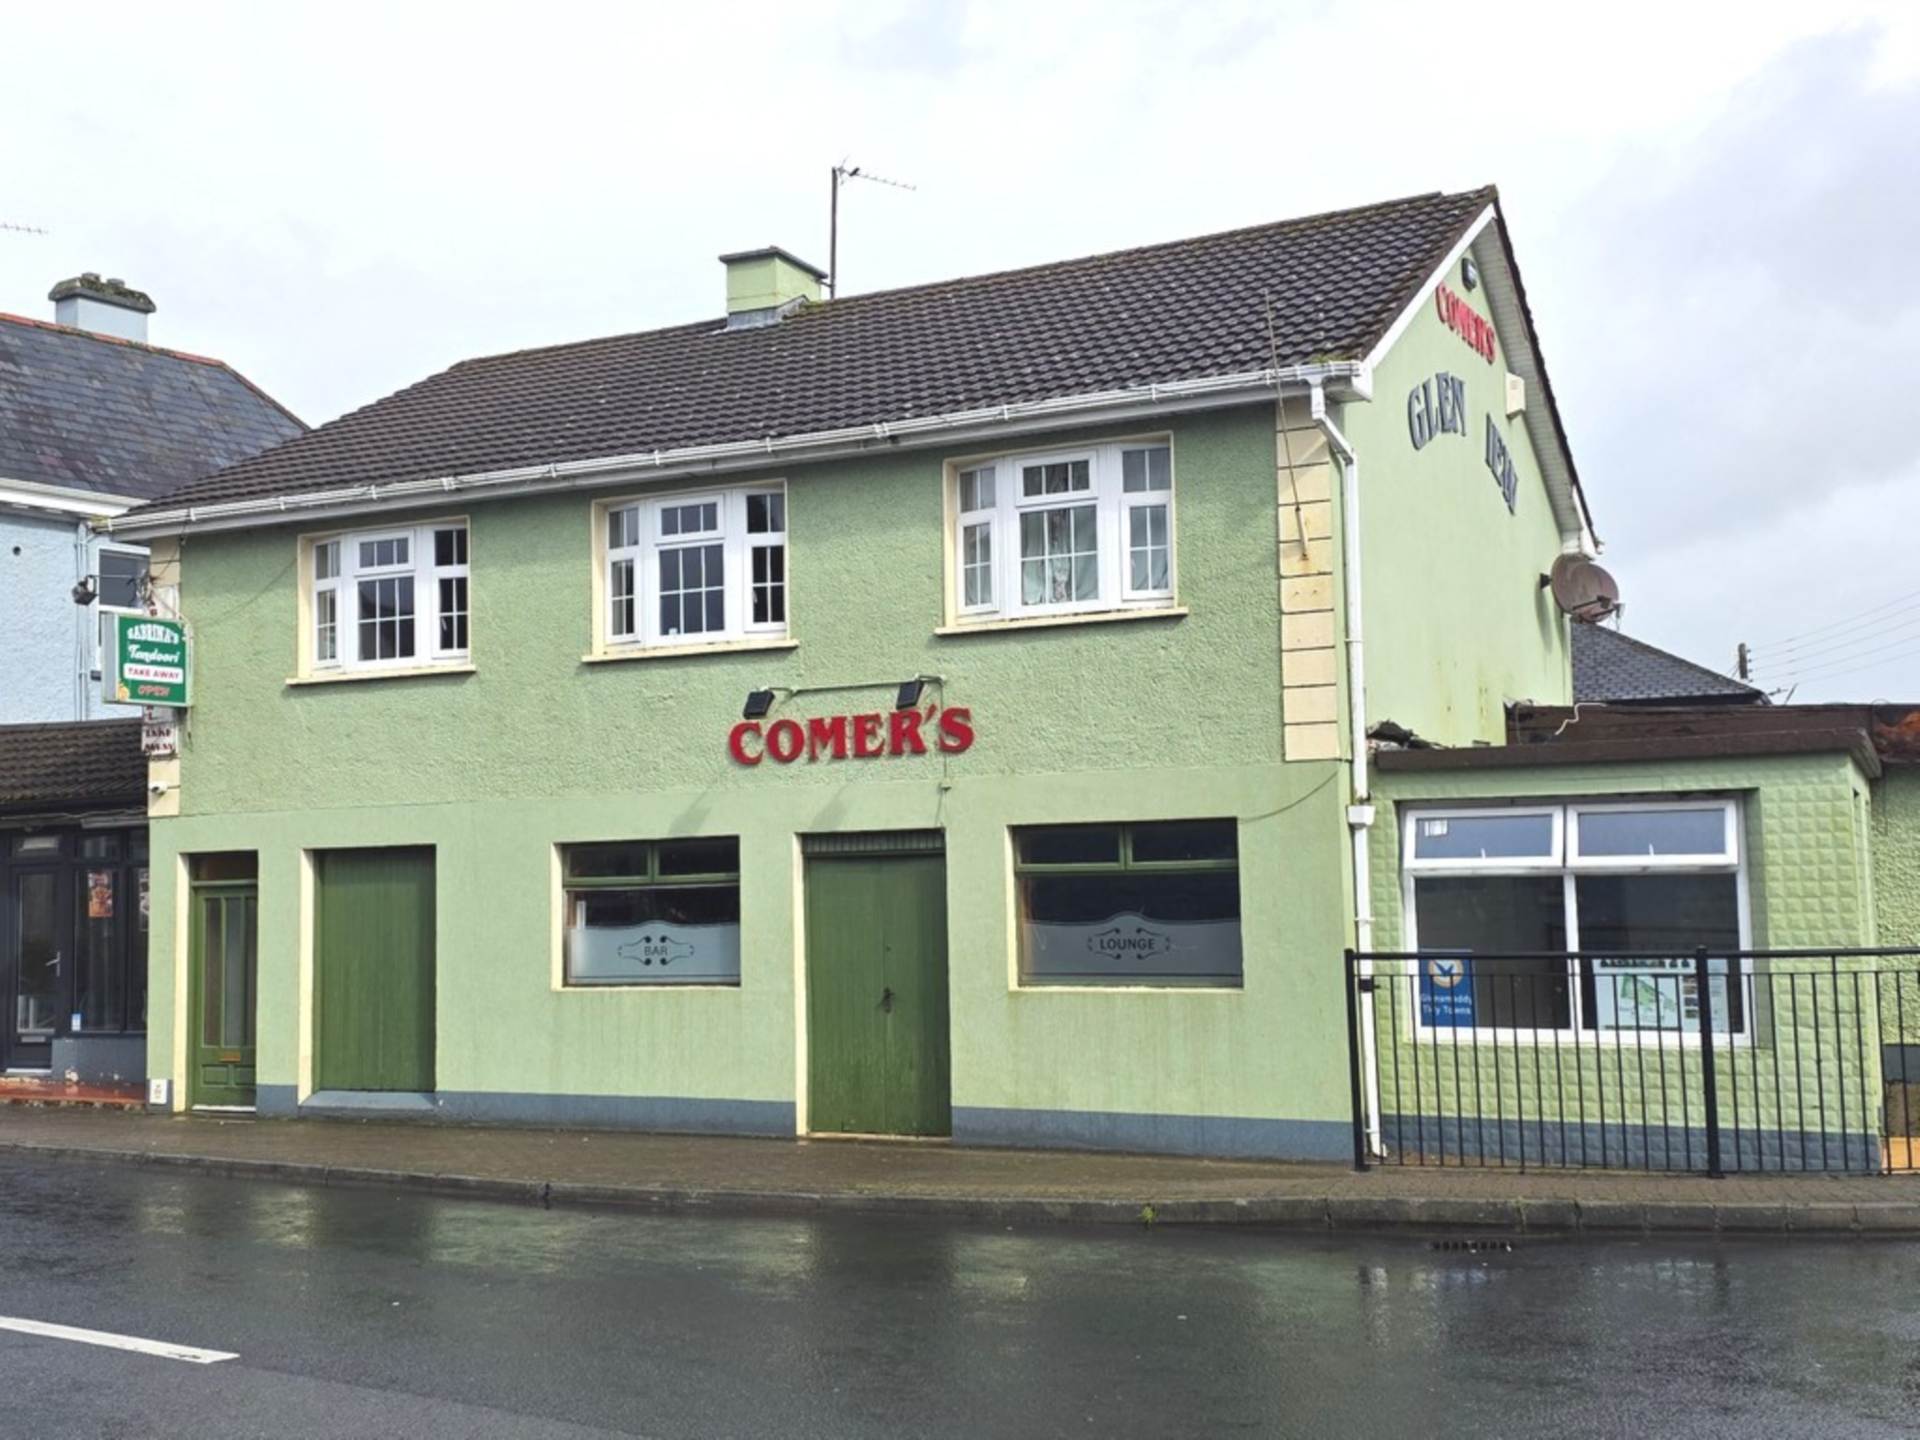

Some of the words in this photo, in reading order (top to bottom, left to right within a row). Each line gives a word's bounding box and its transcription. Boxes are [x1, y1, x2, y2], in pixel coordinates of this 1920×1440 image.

[1407, 371, 1466, 451] GLEN
[128, 667, 151, 677] TAKE
[153, 669, 179, 680] AWAY
[729, 704, 974, 766] COMER'S
[644, 946, 668, 956] BAR
[1100, 938, 1155, 951] LOUNGE
